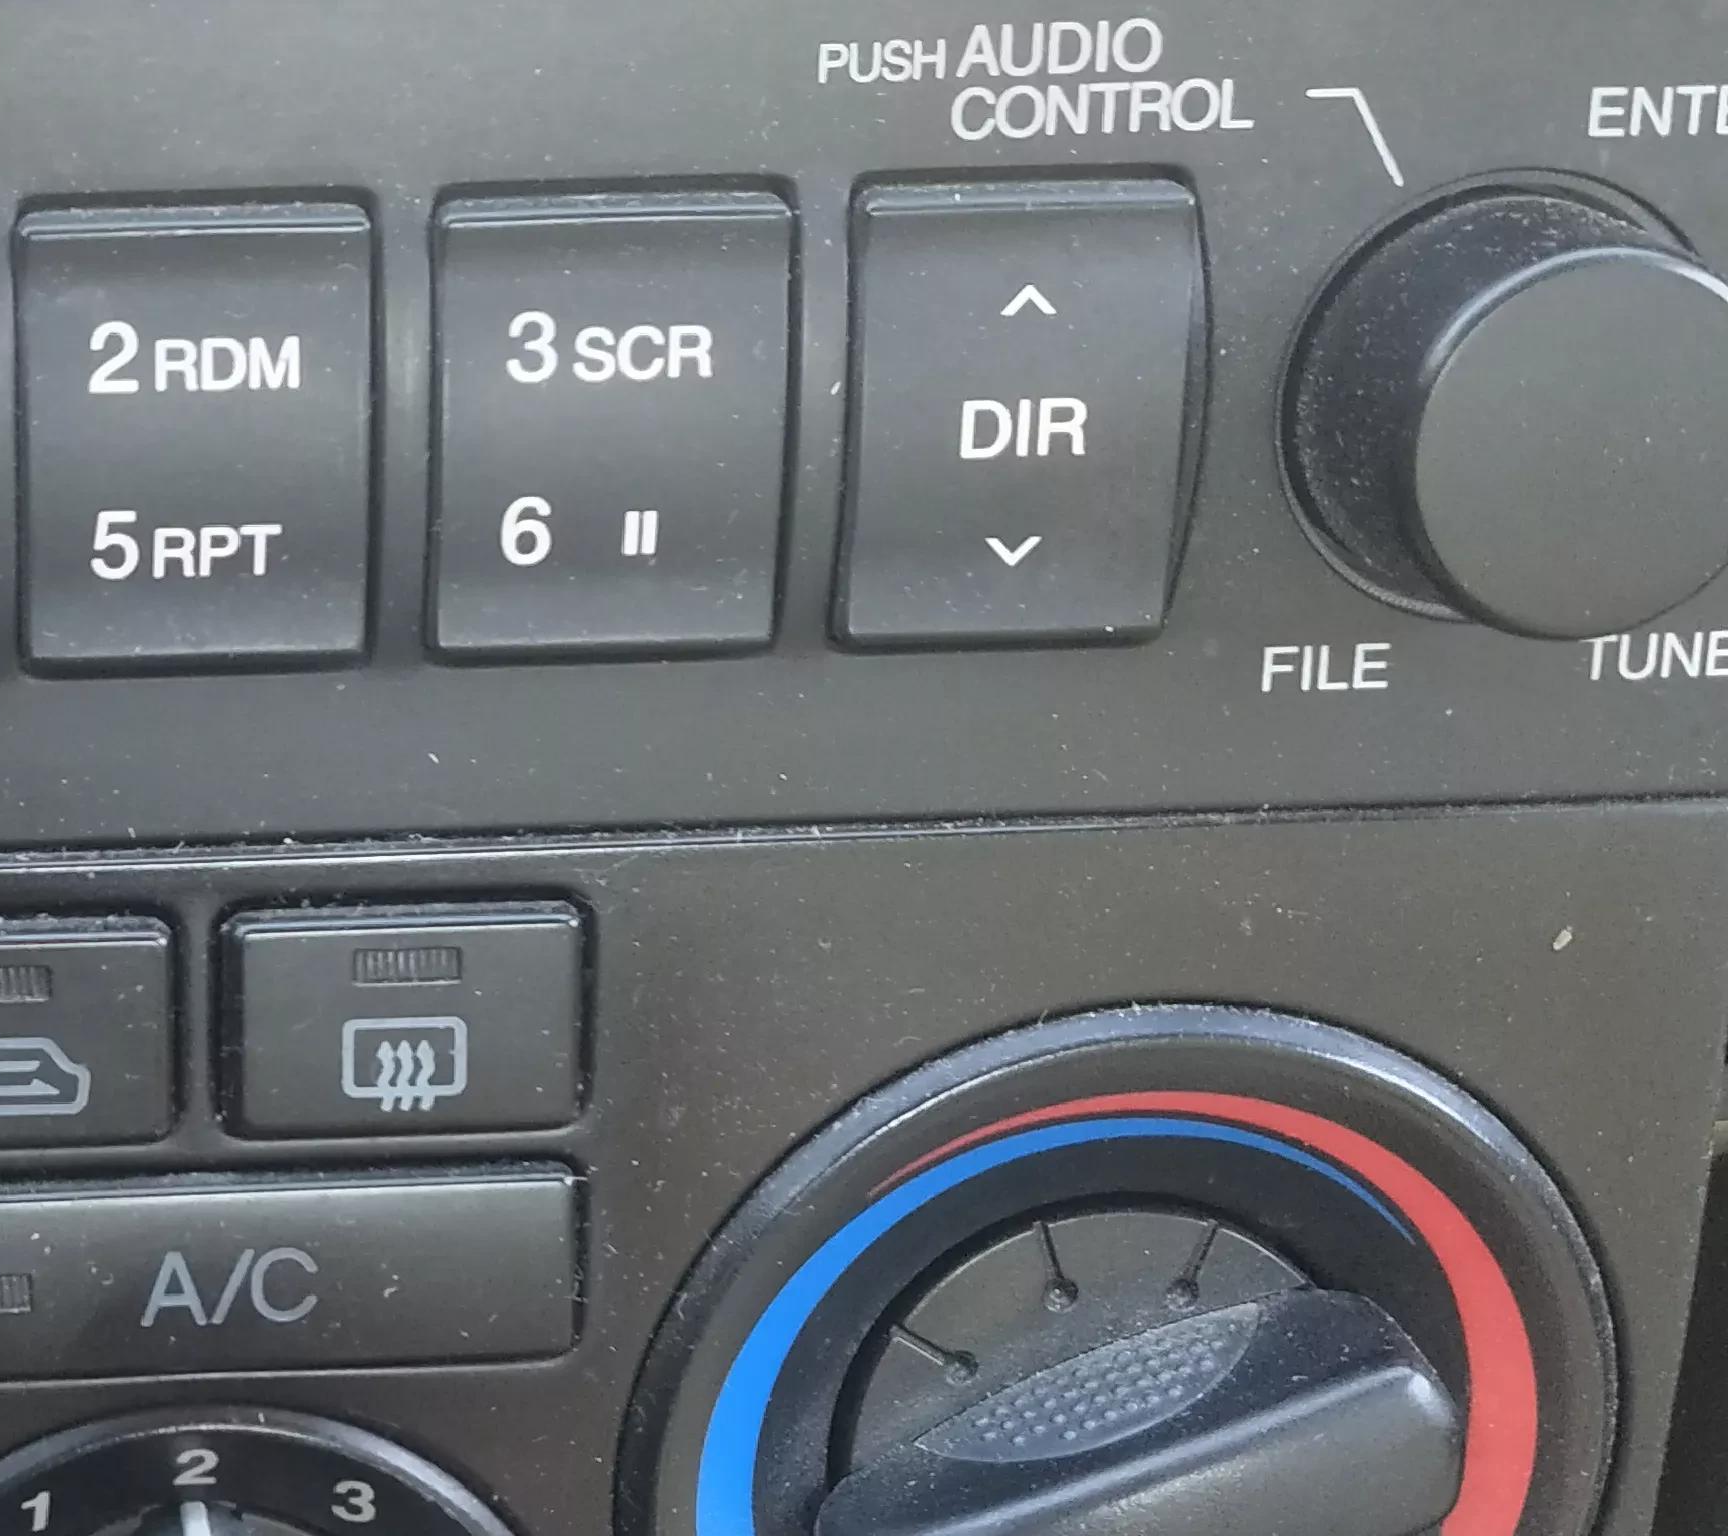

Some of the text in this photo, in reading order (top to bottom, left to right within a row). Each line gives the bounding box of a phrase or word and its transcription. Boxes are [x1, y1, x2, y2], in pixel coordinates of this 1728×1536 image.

[818, 17, 1163, 84] PUSH AUDIO
[951, 78, 1255, 141] CONTROL
[154, 335, 301, 392] RDM
[573, 325, 712, 382] SCR
[959, 397, 1087, 459] DIR
[153, 524, 282, 579] RPT
[501, 496, 551, 566] 6
[1261, 642, 1391, 692] FILE
[139, 1247, 319, 1328] A/C
[172, 1448, 219, 1487] 2
[20, 1491, 52, 1533] 1
[331, 1480, 377, 1522] 3
